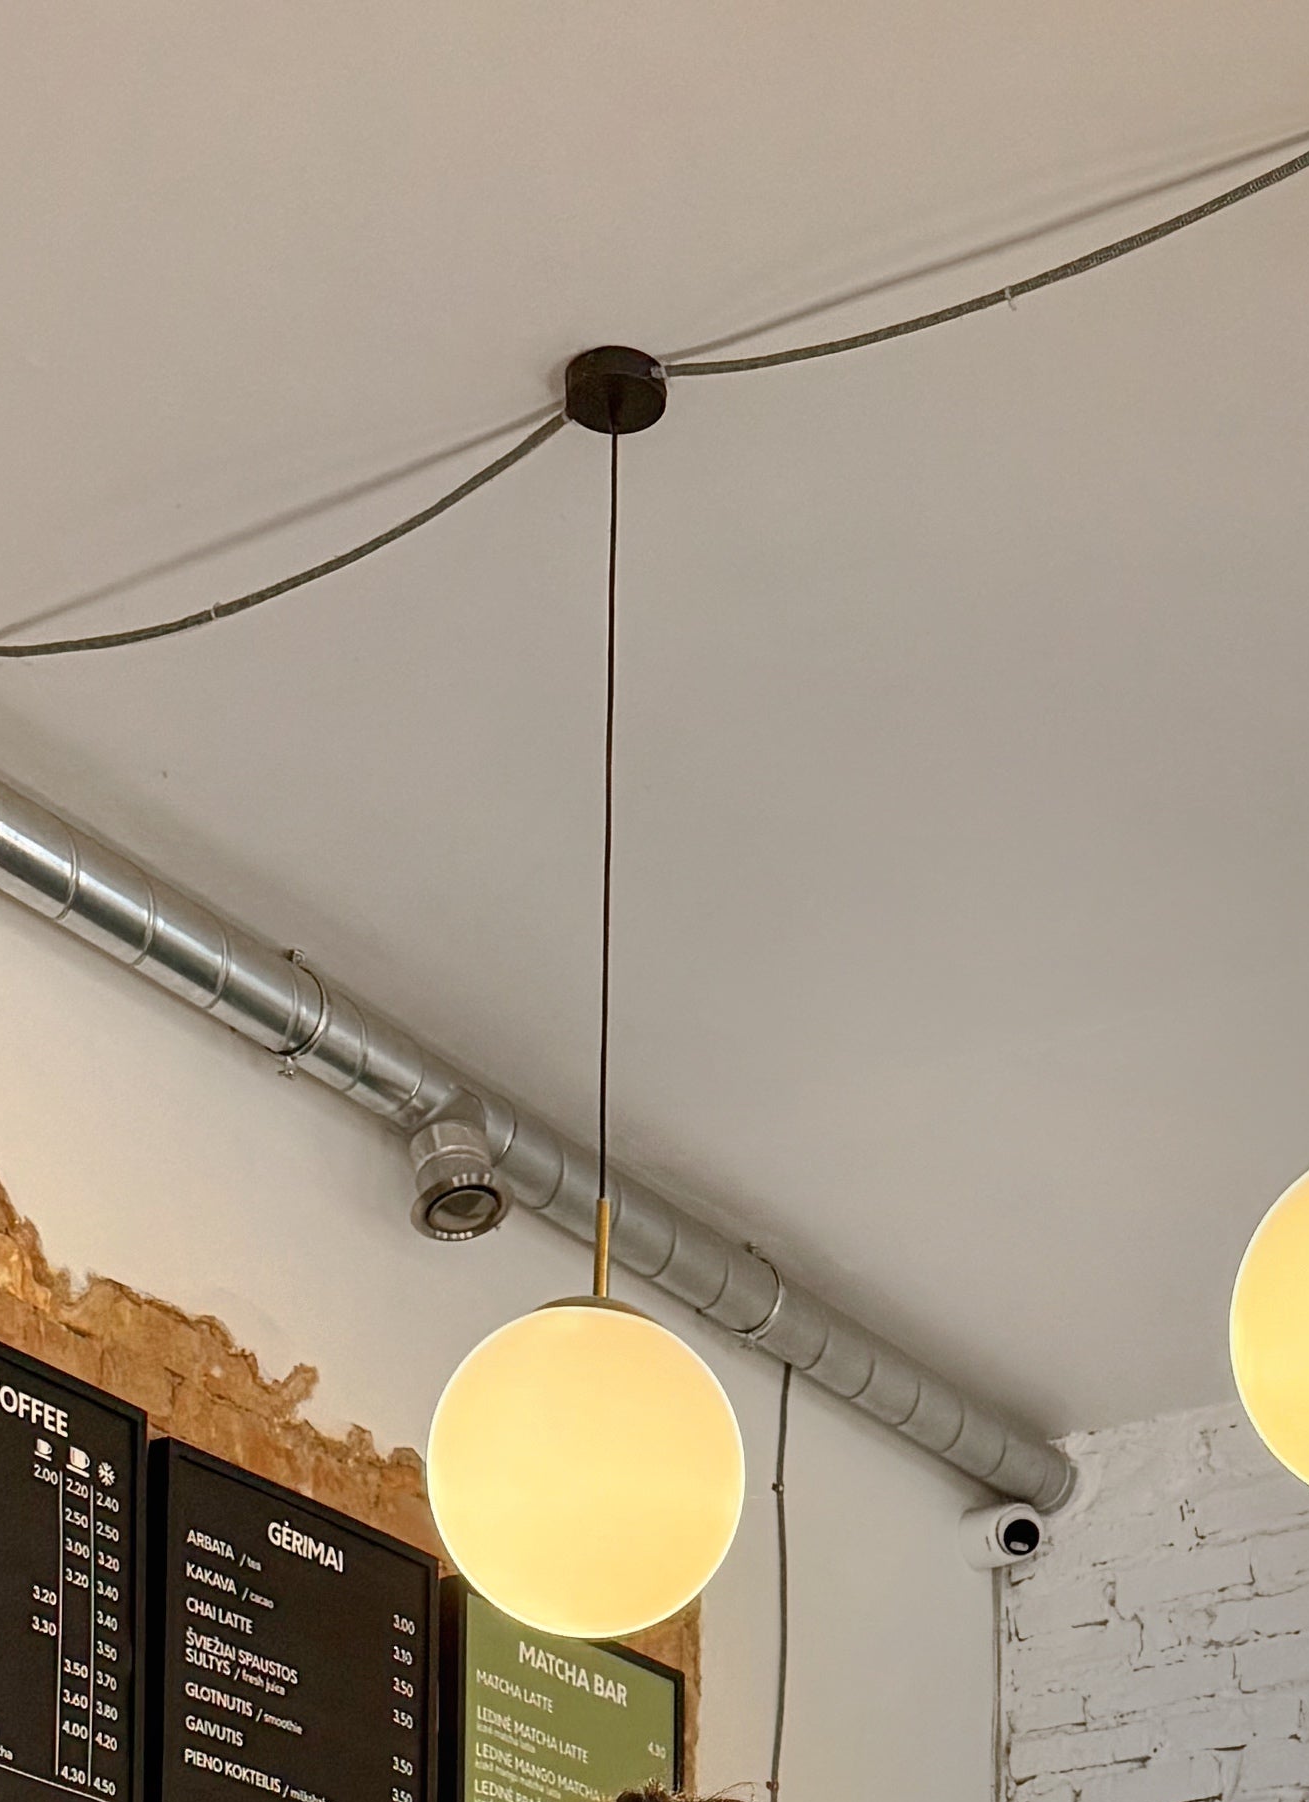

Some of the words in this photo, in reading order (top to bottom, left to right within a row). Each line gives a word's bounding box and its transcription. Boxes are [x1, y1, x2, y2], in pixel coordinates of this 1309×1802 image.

[33, 1463, 58, 1486] 2.00
[65, 1478, 89, 1499] 2.20
[96, 1492, 119, 1513] 2.40
[65, 1507, 89, 1529] 2.50
[95, 1521, 119, 1543] 2.50
[65, 1537, 90, 1559] 3.00
[186, 1529, 235, 1561] ARBATA
[267, 1520, 344, 1573] GĖRIMAI
[97, 1551, 120, 1573] 3.20
[65, 1567, 89, 1589] 3.20
[185, 1561, 237, 1595] KAKAVA
[32, 1585, 57, 1606] 3.20
[31, 1615, 57, 1637] 3.30
[185, 1597, 216, 1621] CHAI
[218, 1608, 253, 1635] LATTE
[96, 1640, 118, 1662] 3.50
[185, 1647, 231, 1676] SULTYS
[63, 1658, 89, 1680] 3.50
[238, 1650, 298, 1685] SPAUSTOS
[519, 1641, 590, 1692] MATCHA
[593, 1673, 628, 1707] BAR
[393, 1677, 414, 1697] 3.50
[476, 1669, 522, 1701] MATCHA
[523, 1689, 554, 1714] LATTE
[62, 1689, 89, 1710] 3.60
[184, 1682, 253, 1717] GLOTNUTIS
[61, 1720, 89, 1740] 4.00
[393, 1708, 414, 1730] 3.50
[185, 1715, 244, 1747] GAIVUTIS
[514, 1720, 558, 1751] MATCHA
[559, 1740, 589, 1765] LATTE
[60, 1765, 86, 1785] 4.30
[184, 1748, 223, 1773] PIENO
[224, 1760, 282, 1793] KOKTEILIS
[392, 1756, 413, 1776] 3.50
[515, 1756, 556, 1785] MANGO
[93, 1776, 116, 1796] 4.50
